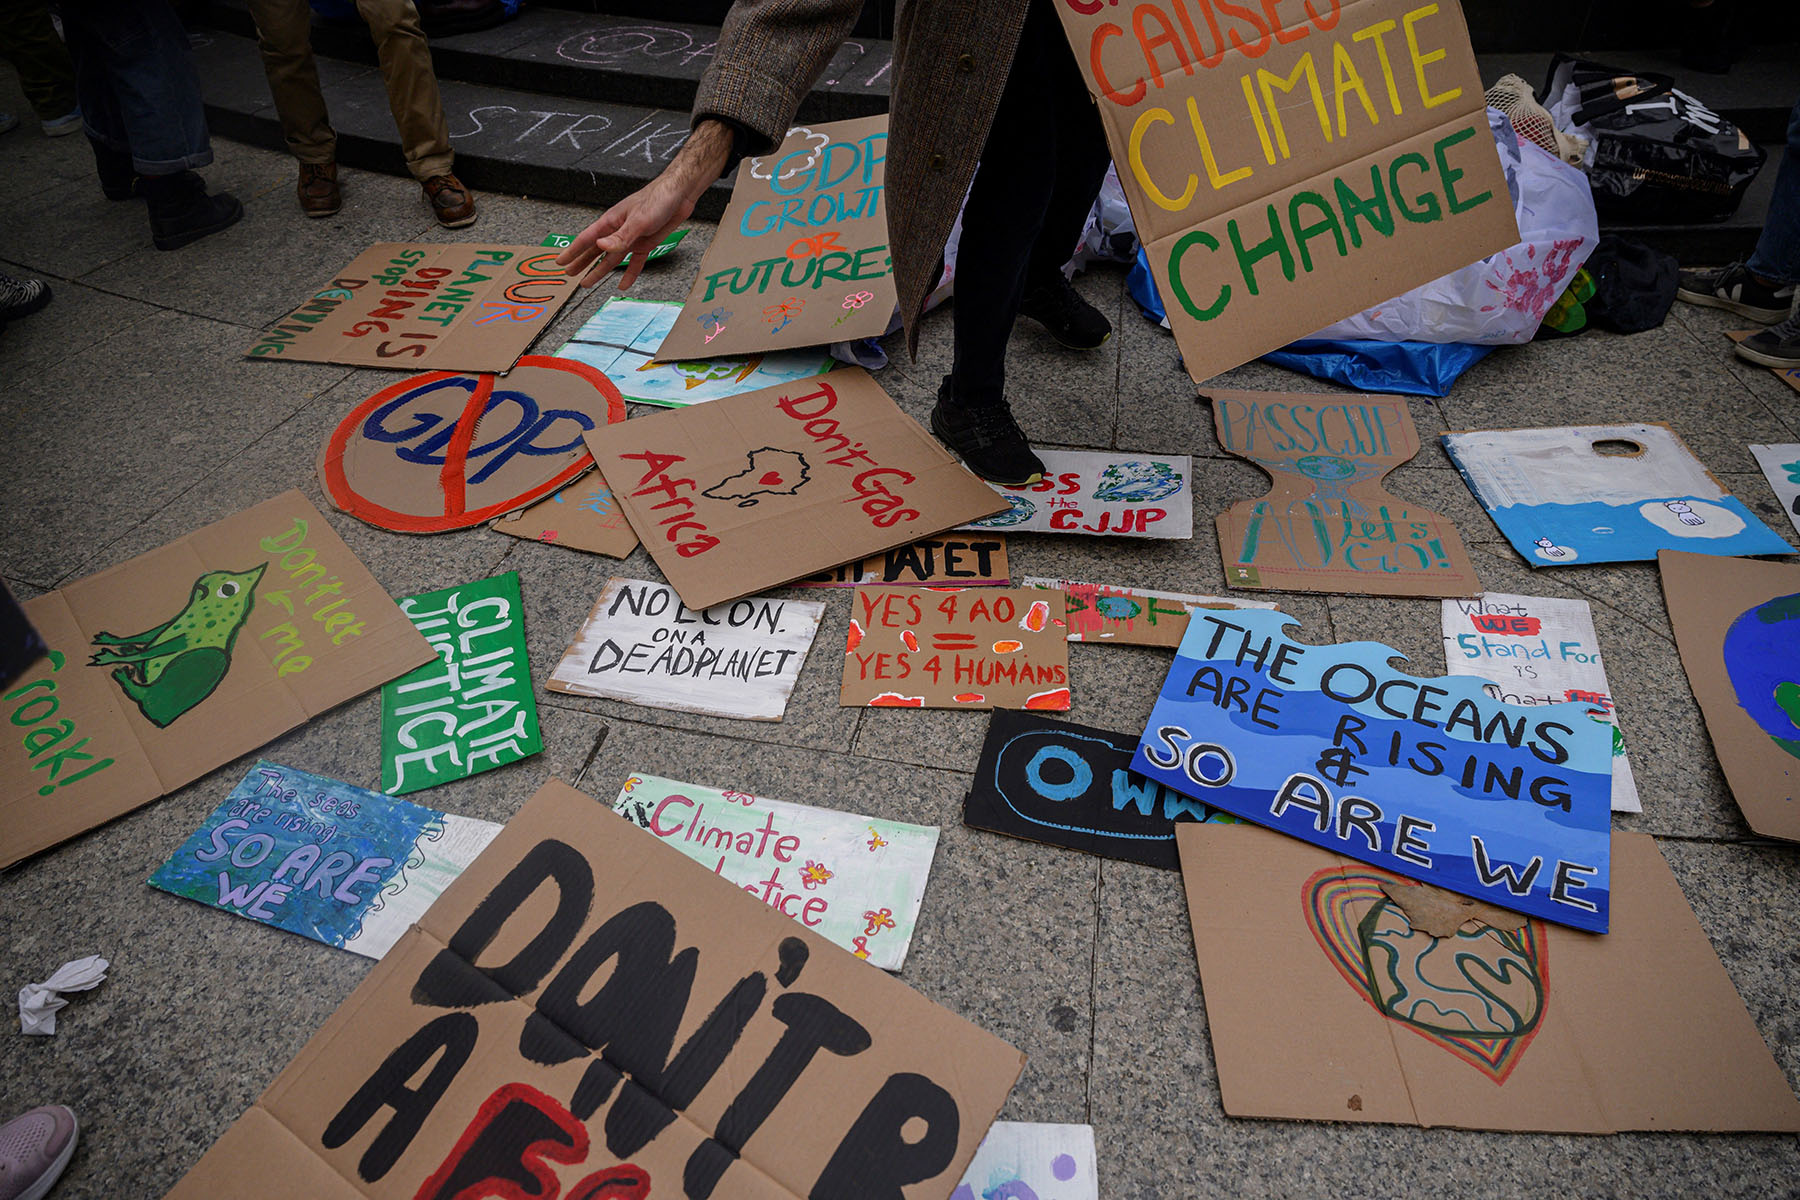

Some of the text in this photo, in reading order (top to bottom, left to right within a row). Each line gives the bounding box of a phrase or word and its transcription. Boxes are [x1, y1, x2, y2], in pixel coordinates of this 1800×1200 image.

[449, 106, 690, 163] STRIK
[1129, 3, 1463, 212] CLIMATE
[770, 132, 889, 196] GDP
[786, 232, 847, 259] OR
[1168, 126, 1493, 322] CHANGE
[371, 249, 426, 287] STOP
[473, 252, 569, 327] OUR
[251, 278, 369, 356] DENYING
[342, 267, 453, 338] DYING
[376, 250, 514, 359] PLANET IS
[363, 376, 596, 485] GDP
[774, 382, 879, 467] Don't
[617, 450, 721, 558] Africa
[1046, 497, 1078, 509] the
[1342, 539, 1450, 574] GO!
[311, 597, 367, 646] let
[608, 585, 670, 619] NO
[859, 591, 922, 629] YES
[937, 594, 958, 625] 4
[1480, 616, 1530, 633] WE
[260, 620, 313, 679] me
[652, 627, 706, 646] ON A
[855, 652, 1067, 688] YES 4 HUMANS
[1559, 641, 1600, 665] For
[456, 596, 529, 775] CLIMATE
[1203, 616, 1575, 765] THE OCEANS
[3, 650, 116, 797] roak!
[1186, 665, 1573, 814] ARE RISING
[228, 798, 338, 845] are rising
[254, 769, 361, 820] The seas
[1143, 725, 1600, 913] SO ARE WE
[194, 818, 395, 905] SO ARE
[649, 794, 801, 864] Climate
[217, 870, 294, 921] WE
[321, 1011, 480, 1185] A
